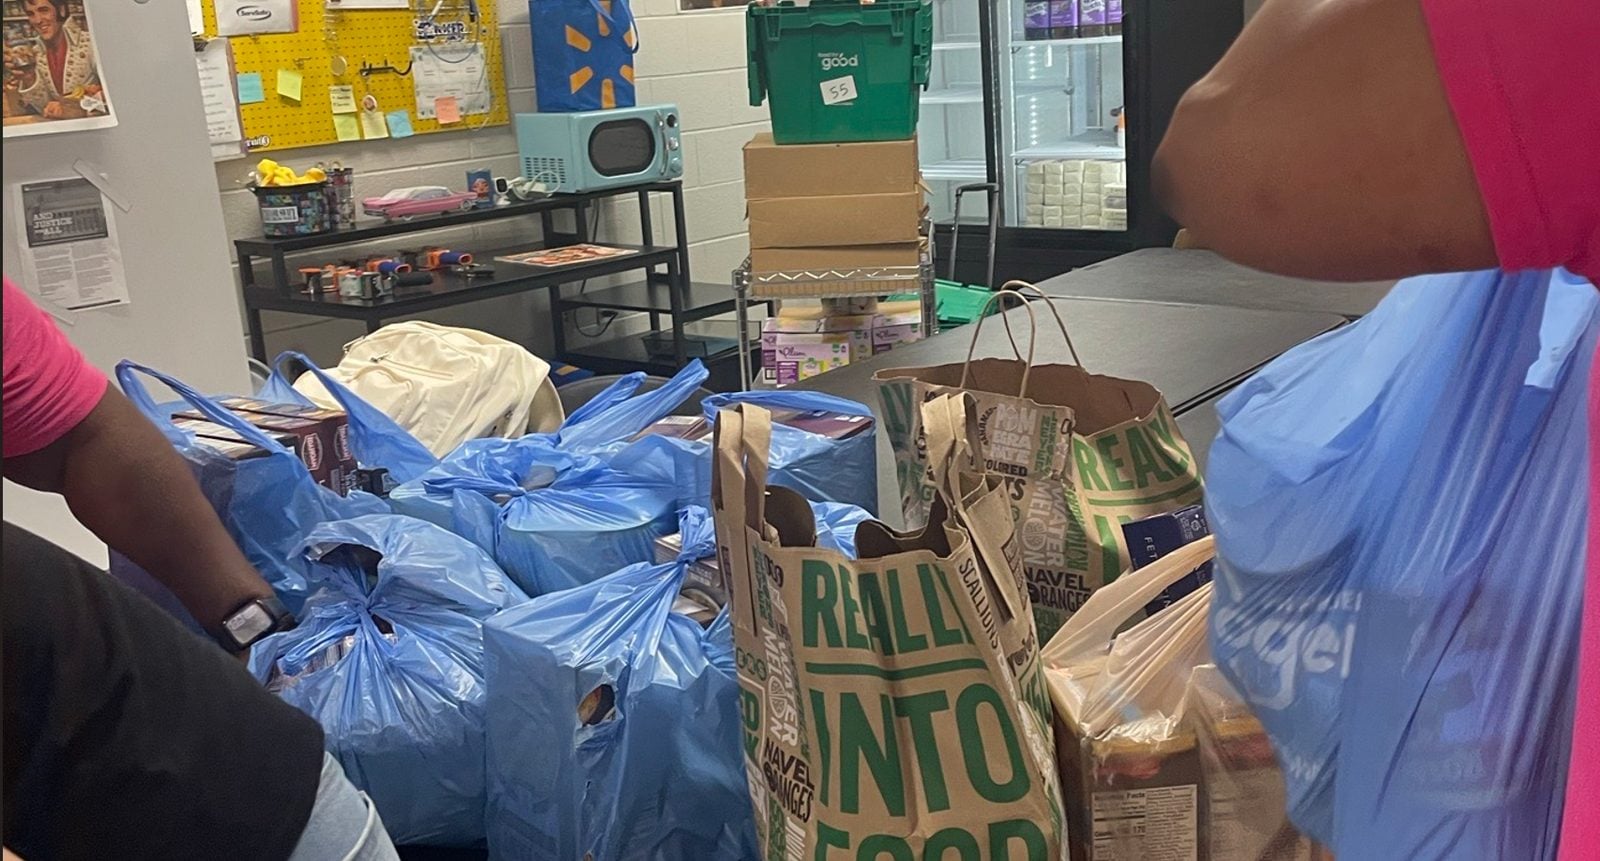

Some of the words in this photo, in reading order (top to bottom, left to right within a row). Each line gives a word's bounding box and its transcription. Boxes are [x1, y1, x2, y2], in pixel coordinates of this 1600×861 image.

[822, 54, 858, 70] good
[33, 212, 54, 221] AND
[33, 218, 73, 229] JUSTICE
[1022, 480, 1050, 565] MELON
[1046, 482, 1067, 567] WATER
[959, 558, 999, 649] SCALLIONS
[1024, 567, 1091, 592] NAVEL
[762, 627, 787, 741] MELON
[778, 641, 798, 746] WATER
[764, 738, 815, 791] NAVEL
[809, 683, 1031, 817] INTO
